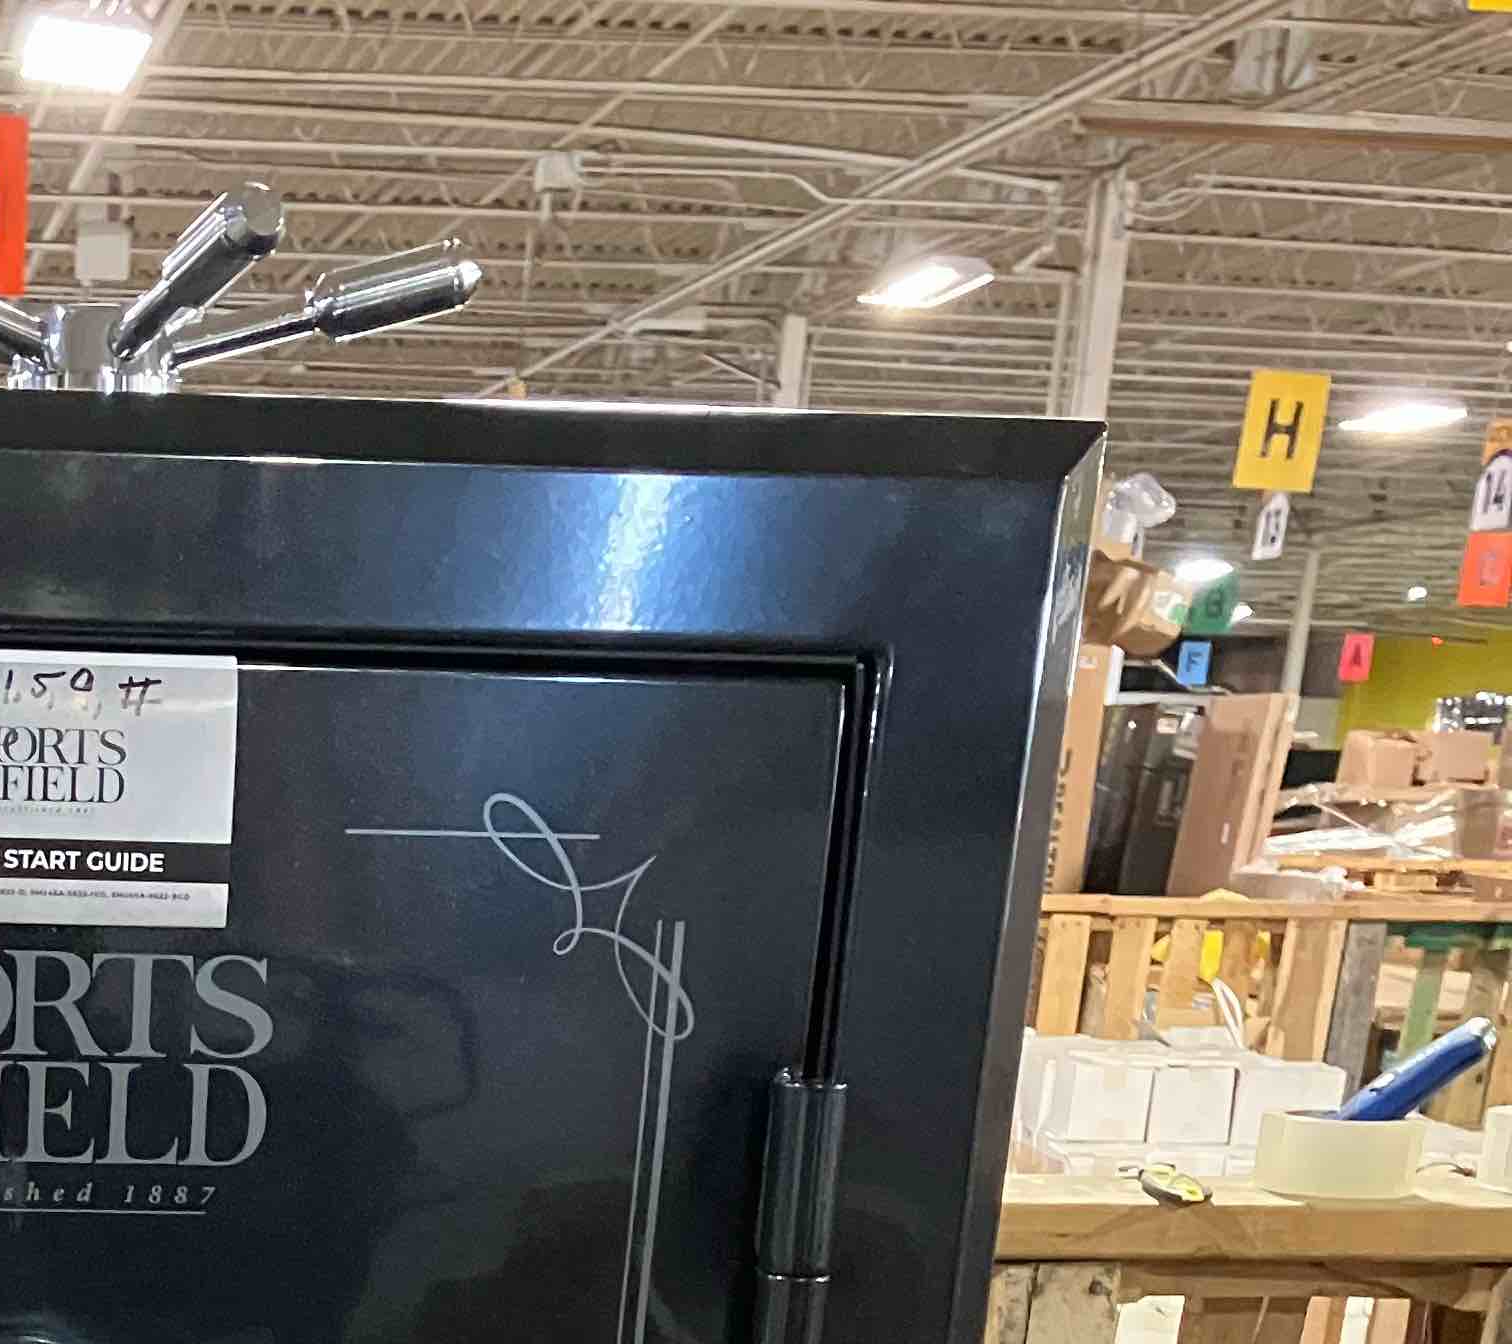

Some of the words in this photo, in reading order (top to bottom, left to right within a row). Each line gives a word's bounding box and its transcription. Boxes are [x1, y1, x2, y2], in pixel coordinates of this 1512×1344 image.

[1259, 398, 1304, 460] H
[3, 849, 81, 871] START
[86, 851, 166, 873] GUIDE
[124, 1183, 216, 1205] 1887
